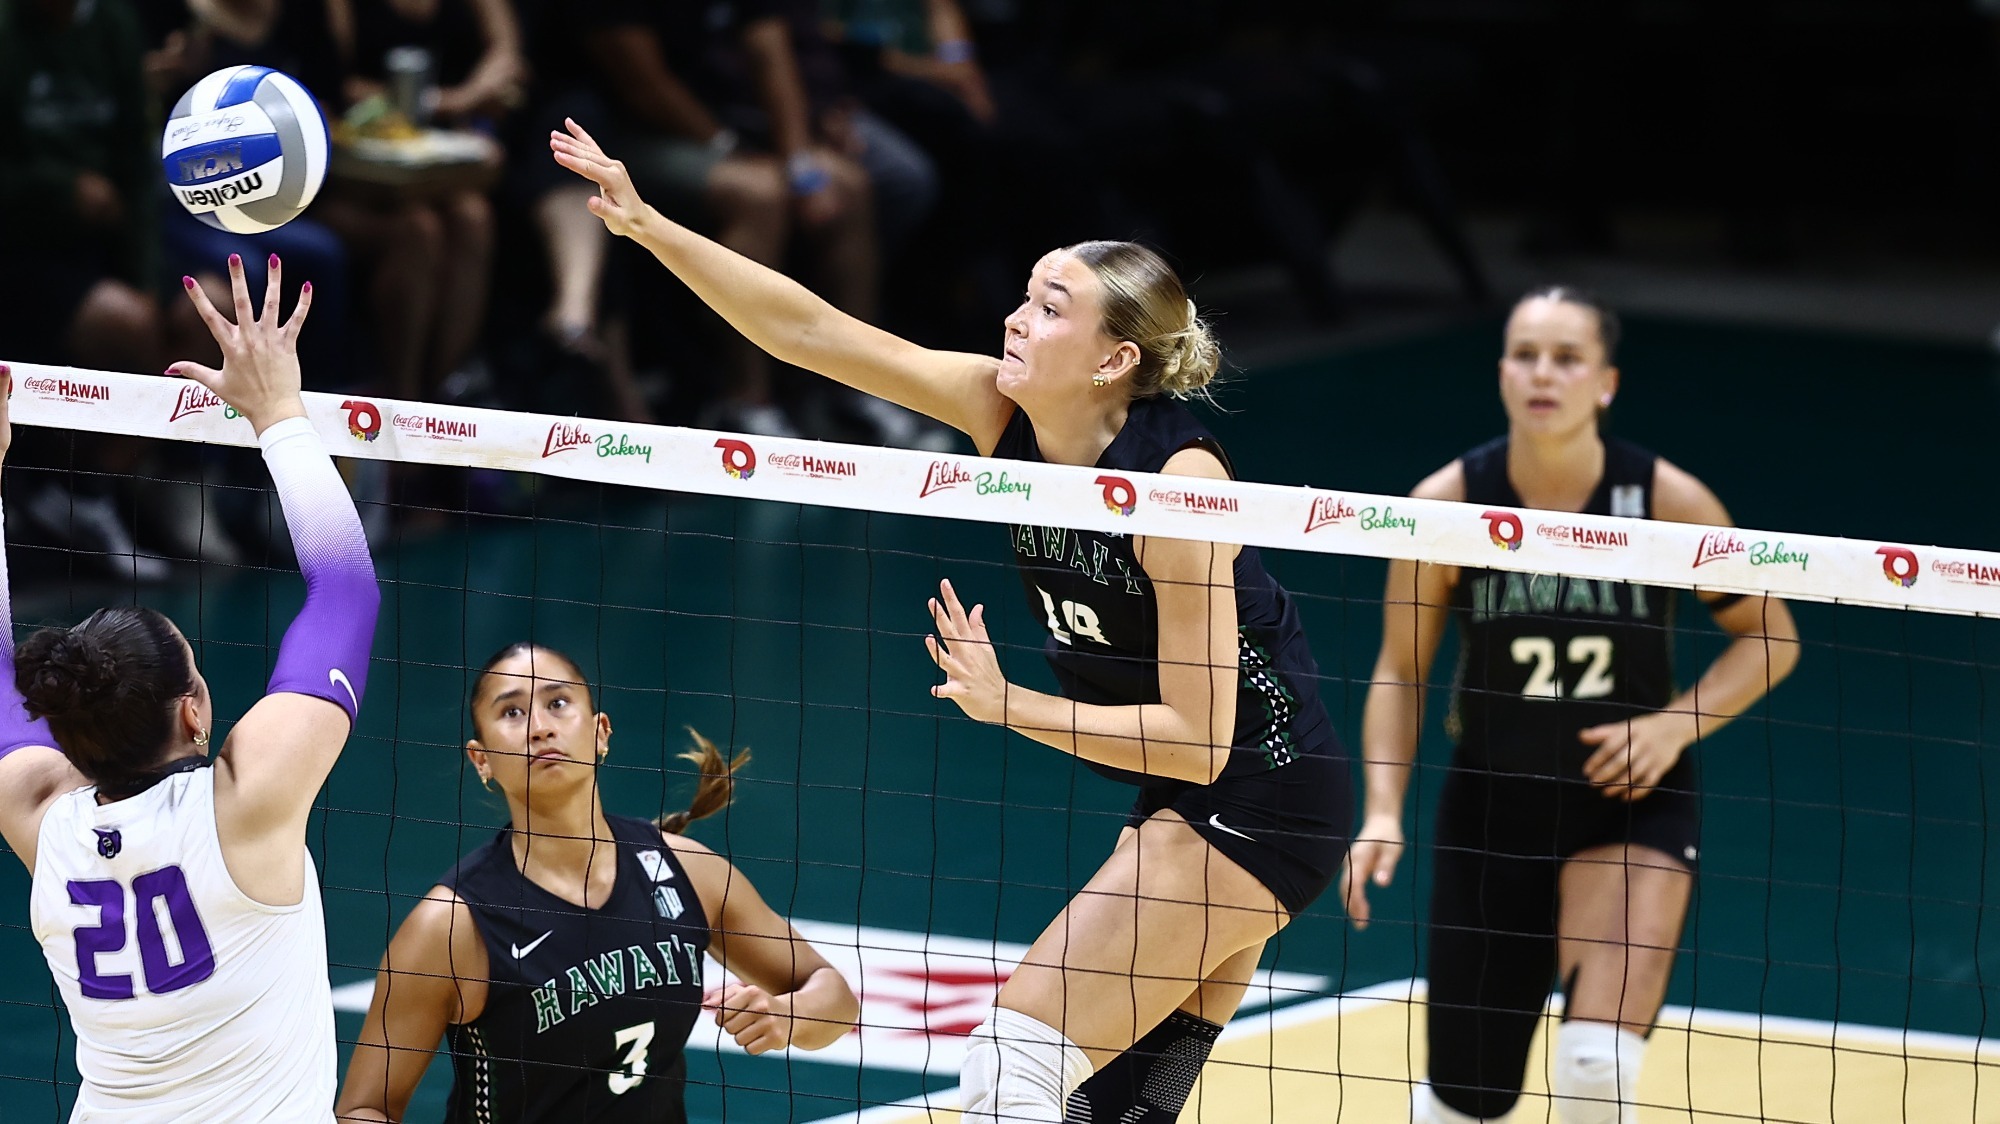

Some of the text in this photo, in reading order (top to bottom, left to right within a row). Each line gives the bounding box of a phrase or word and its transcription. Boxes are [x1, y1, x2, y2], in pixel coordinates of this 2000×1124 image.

[182, 172, 263, 207] molten
[58, 379, 109, 400] HAWAII
[169, 384, 221, 422] Liliha
[425, 417, 477, 438] HAWAII
[542, 422, 652, 463] Liliha Bakery
[802, 456, 856, 476] HAWAII
[920, 461, 1032, 501] Liliha Bakery
[1183, 492, 1238, 512] HAWAII
[1304, 496, 1416, 536] Liliha Bakery
[1572, 526, 1628, 547] HAWAII
[1693, 531, 1809, 571] Liliha Bakery
[1509, 635, 1615, 701] 22
[66, 864, 217, 1000] 20
[608, 1021, 655, 1095] 3
